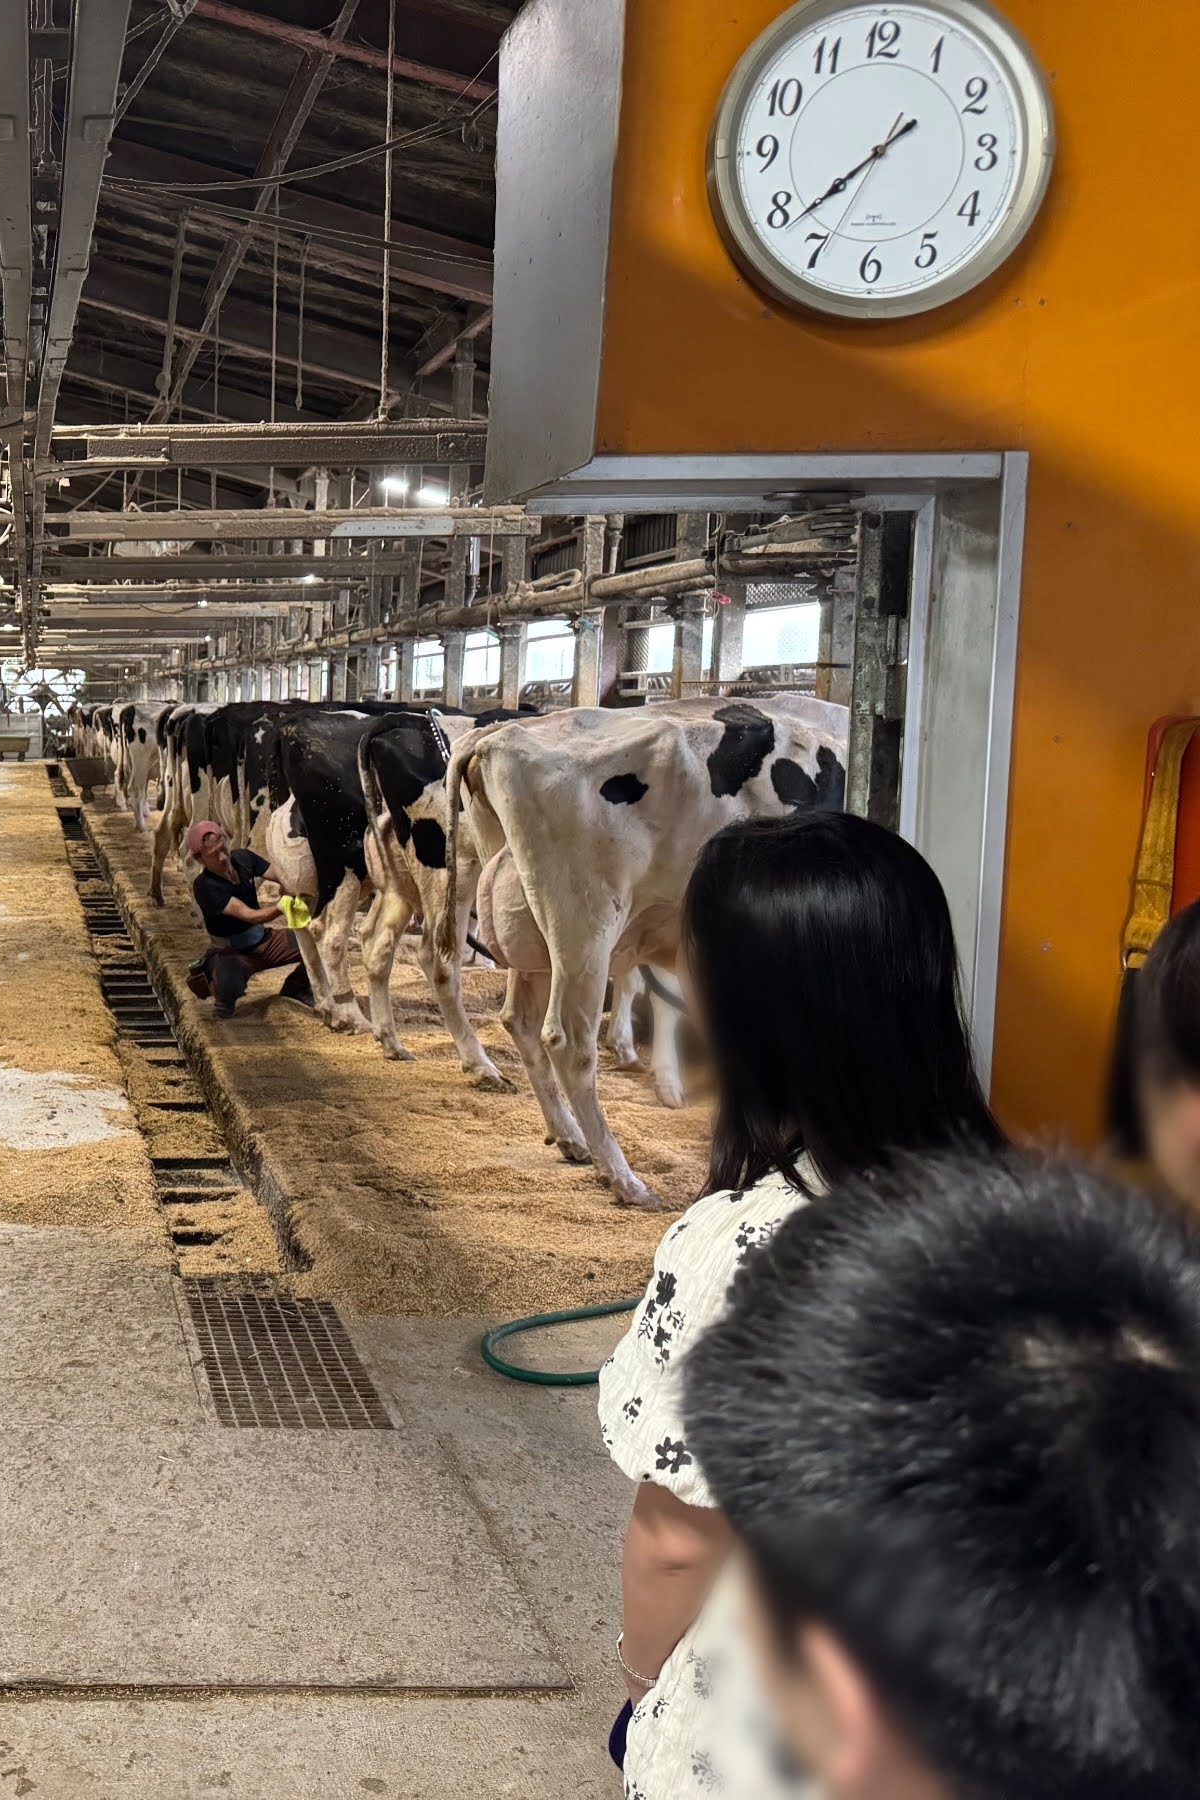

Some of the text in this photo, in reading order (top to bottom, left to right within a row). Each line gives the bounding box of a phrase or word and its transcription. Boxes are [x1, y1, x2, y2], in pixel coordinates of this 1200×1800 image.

[813, 36, 842, 74] 11
[865, 21, 901, 59] 12
[931, 35, 945, 74] 1
[767, 78, 802, 117] 10
[962, 77, 989, 116] 2
[756, 134, 780, 174] 9
[974, 133, 998, 172] 3
[766, 191, 793, 230] 8
[957, 190, 981, 228] 4
[805, 232, 831, 271] 7
[859, 245, 883, 284] 6
[915, 231, 939, 269] 5
